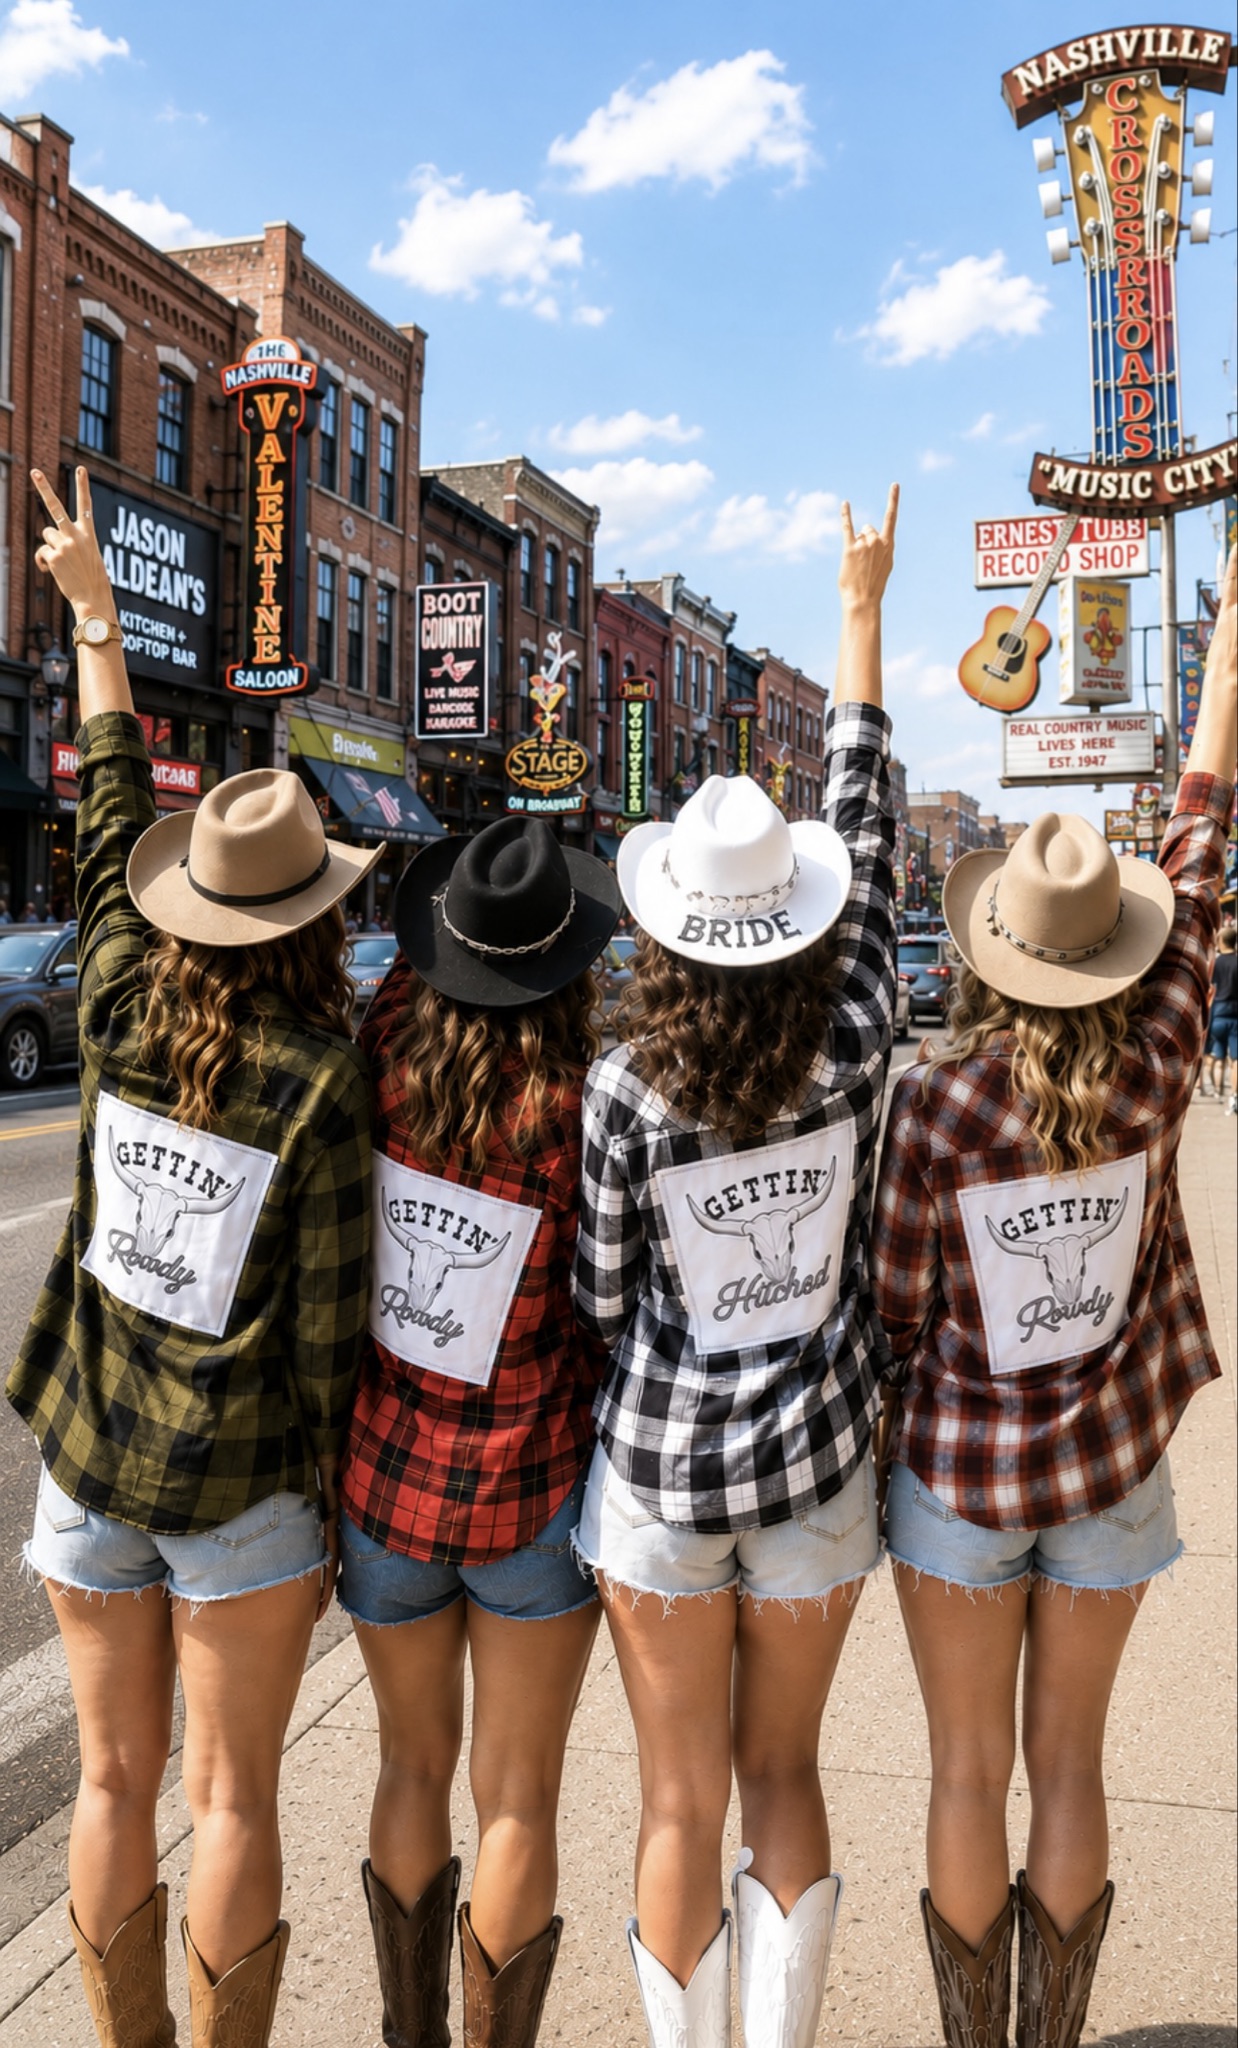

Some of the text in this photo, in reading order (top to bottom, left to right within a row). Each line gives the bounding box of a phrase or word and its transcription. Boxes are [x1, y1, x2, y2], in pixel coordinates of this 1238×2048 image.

[1012, 27, 1226, 96] NASHVILLE
[257, 343, 287, 359] THE
[225, 363, 312, 389] NASHVILLE
[110, 505, 186, 569] JASON
[252, 392, 290, 664] VALENTINE
[1079, 517, 1142, 542] TUBB
[1079, 543, 1140, 571] SHOP
[103, 544, 207, 617] ALDEAN'S
[422, 591, 481, 615] BOOT
[119, 609, 176, 643] KITCHEN
[421, 615, 483, 650] COUNTRY
[172, 646, 198, 670] BAR
[234, 668, 299, 689] SALOON
[424, 687, 446, 700] LIVE
[1009, 718, 1148, 737] REAL COUNTRY MUSIC
[1038, 736, 1117, 752] LIVES HERE
[511, 750, 580, 775] STAGE
[1048, 754, 1108, 769] EST. 1947
[677, 909, 802, 949] BRIDE
[116, 1141, 232, 1200] GETTIN'
[703, 1168, 828, 1220] GETTIN'
[388, 1199, 500, 1254] GETTIN'
[1000, 1197, 1121, 1242] GETTIN'
[1016, 1284, 1115, 1344] Rowdy
